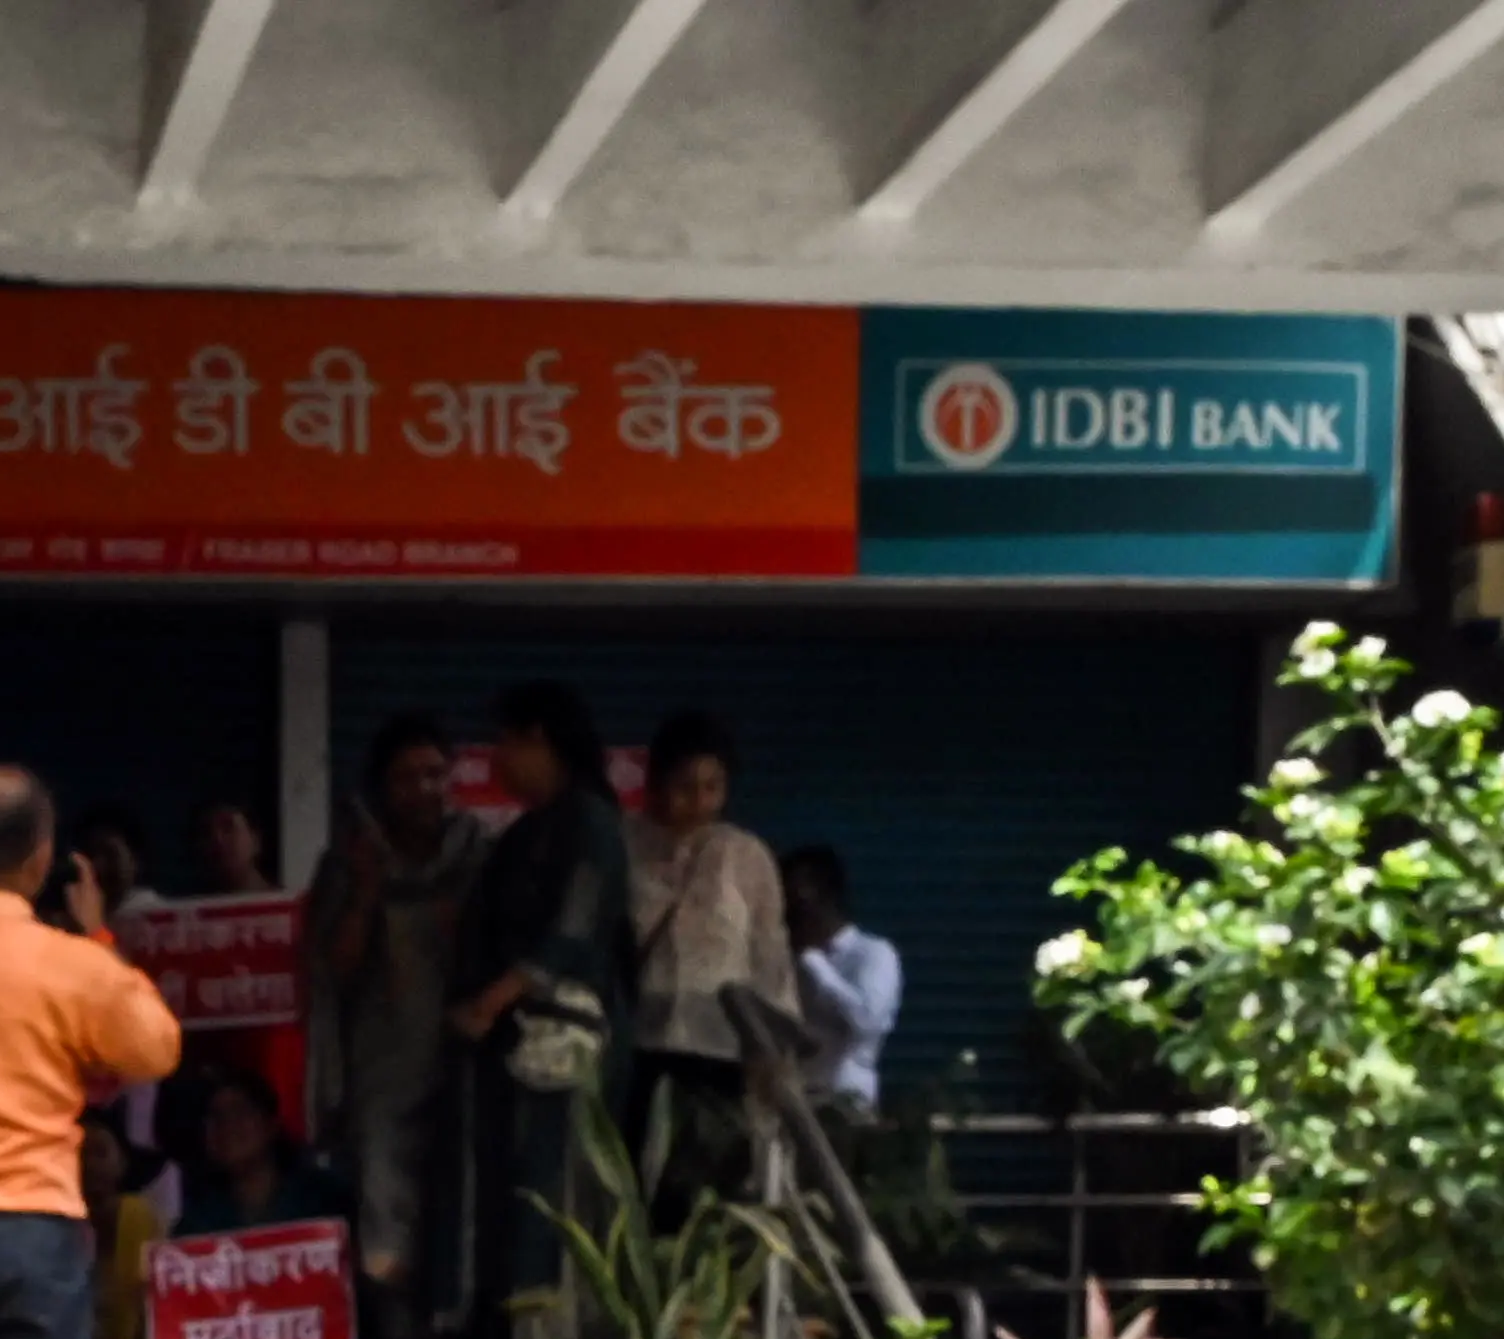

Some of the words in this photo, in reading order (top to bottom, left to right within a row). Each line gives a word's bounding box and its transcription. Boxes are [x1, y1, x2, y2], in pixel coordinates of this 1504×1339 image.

[173, 342, 259, 457] डी
[282, 345, 380, 457] बी
[403, 350, 575, 475] आई
[613, 349, 783, 460] बैंक
[1030, 386, 1175, 450] IDBI
[1193, 399, 1342, 453] BANK
[154, 1236, 340, 1299] निजीकरण
